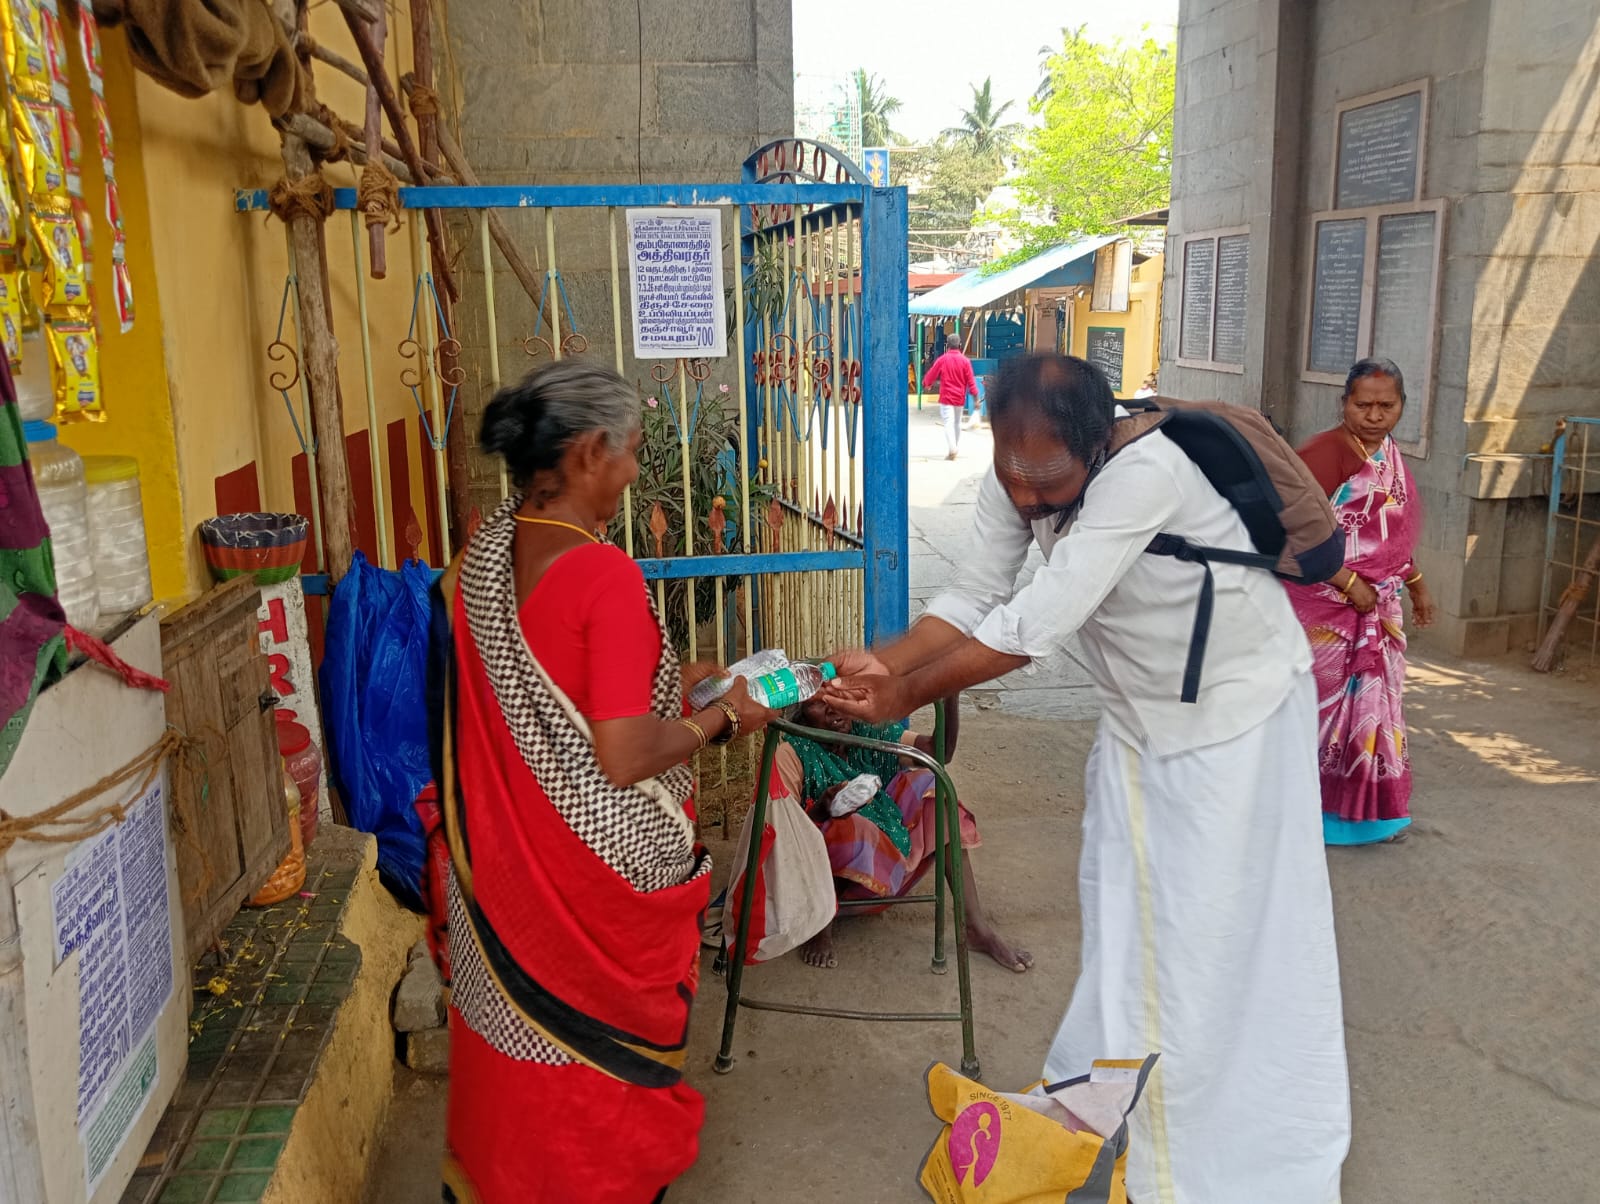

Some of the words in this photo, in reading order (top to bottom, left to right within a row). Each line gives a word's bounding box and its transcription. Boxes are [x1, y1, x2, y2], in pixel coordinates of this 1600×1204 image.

[636, 240, 711, 250] கும்பகோணத்தில்
[637, 249, 711, 263] அத்திவரதர்
[648, 273, 679, 282] நாட்கள்
[680, 273, 712, 283] மட்டுமே
[640, 324, 694, 335] தஞ்சாவூர்
[641, 334, 697, 343] சமயபுரம்
[970, 1091, 999, 1102] SINCE
[1000, 1101, 1011, 1121] 1977
